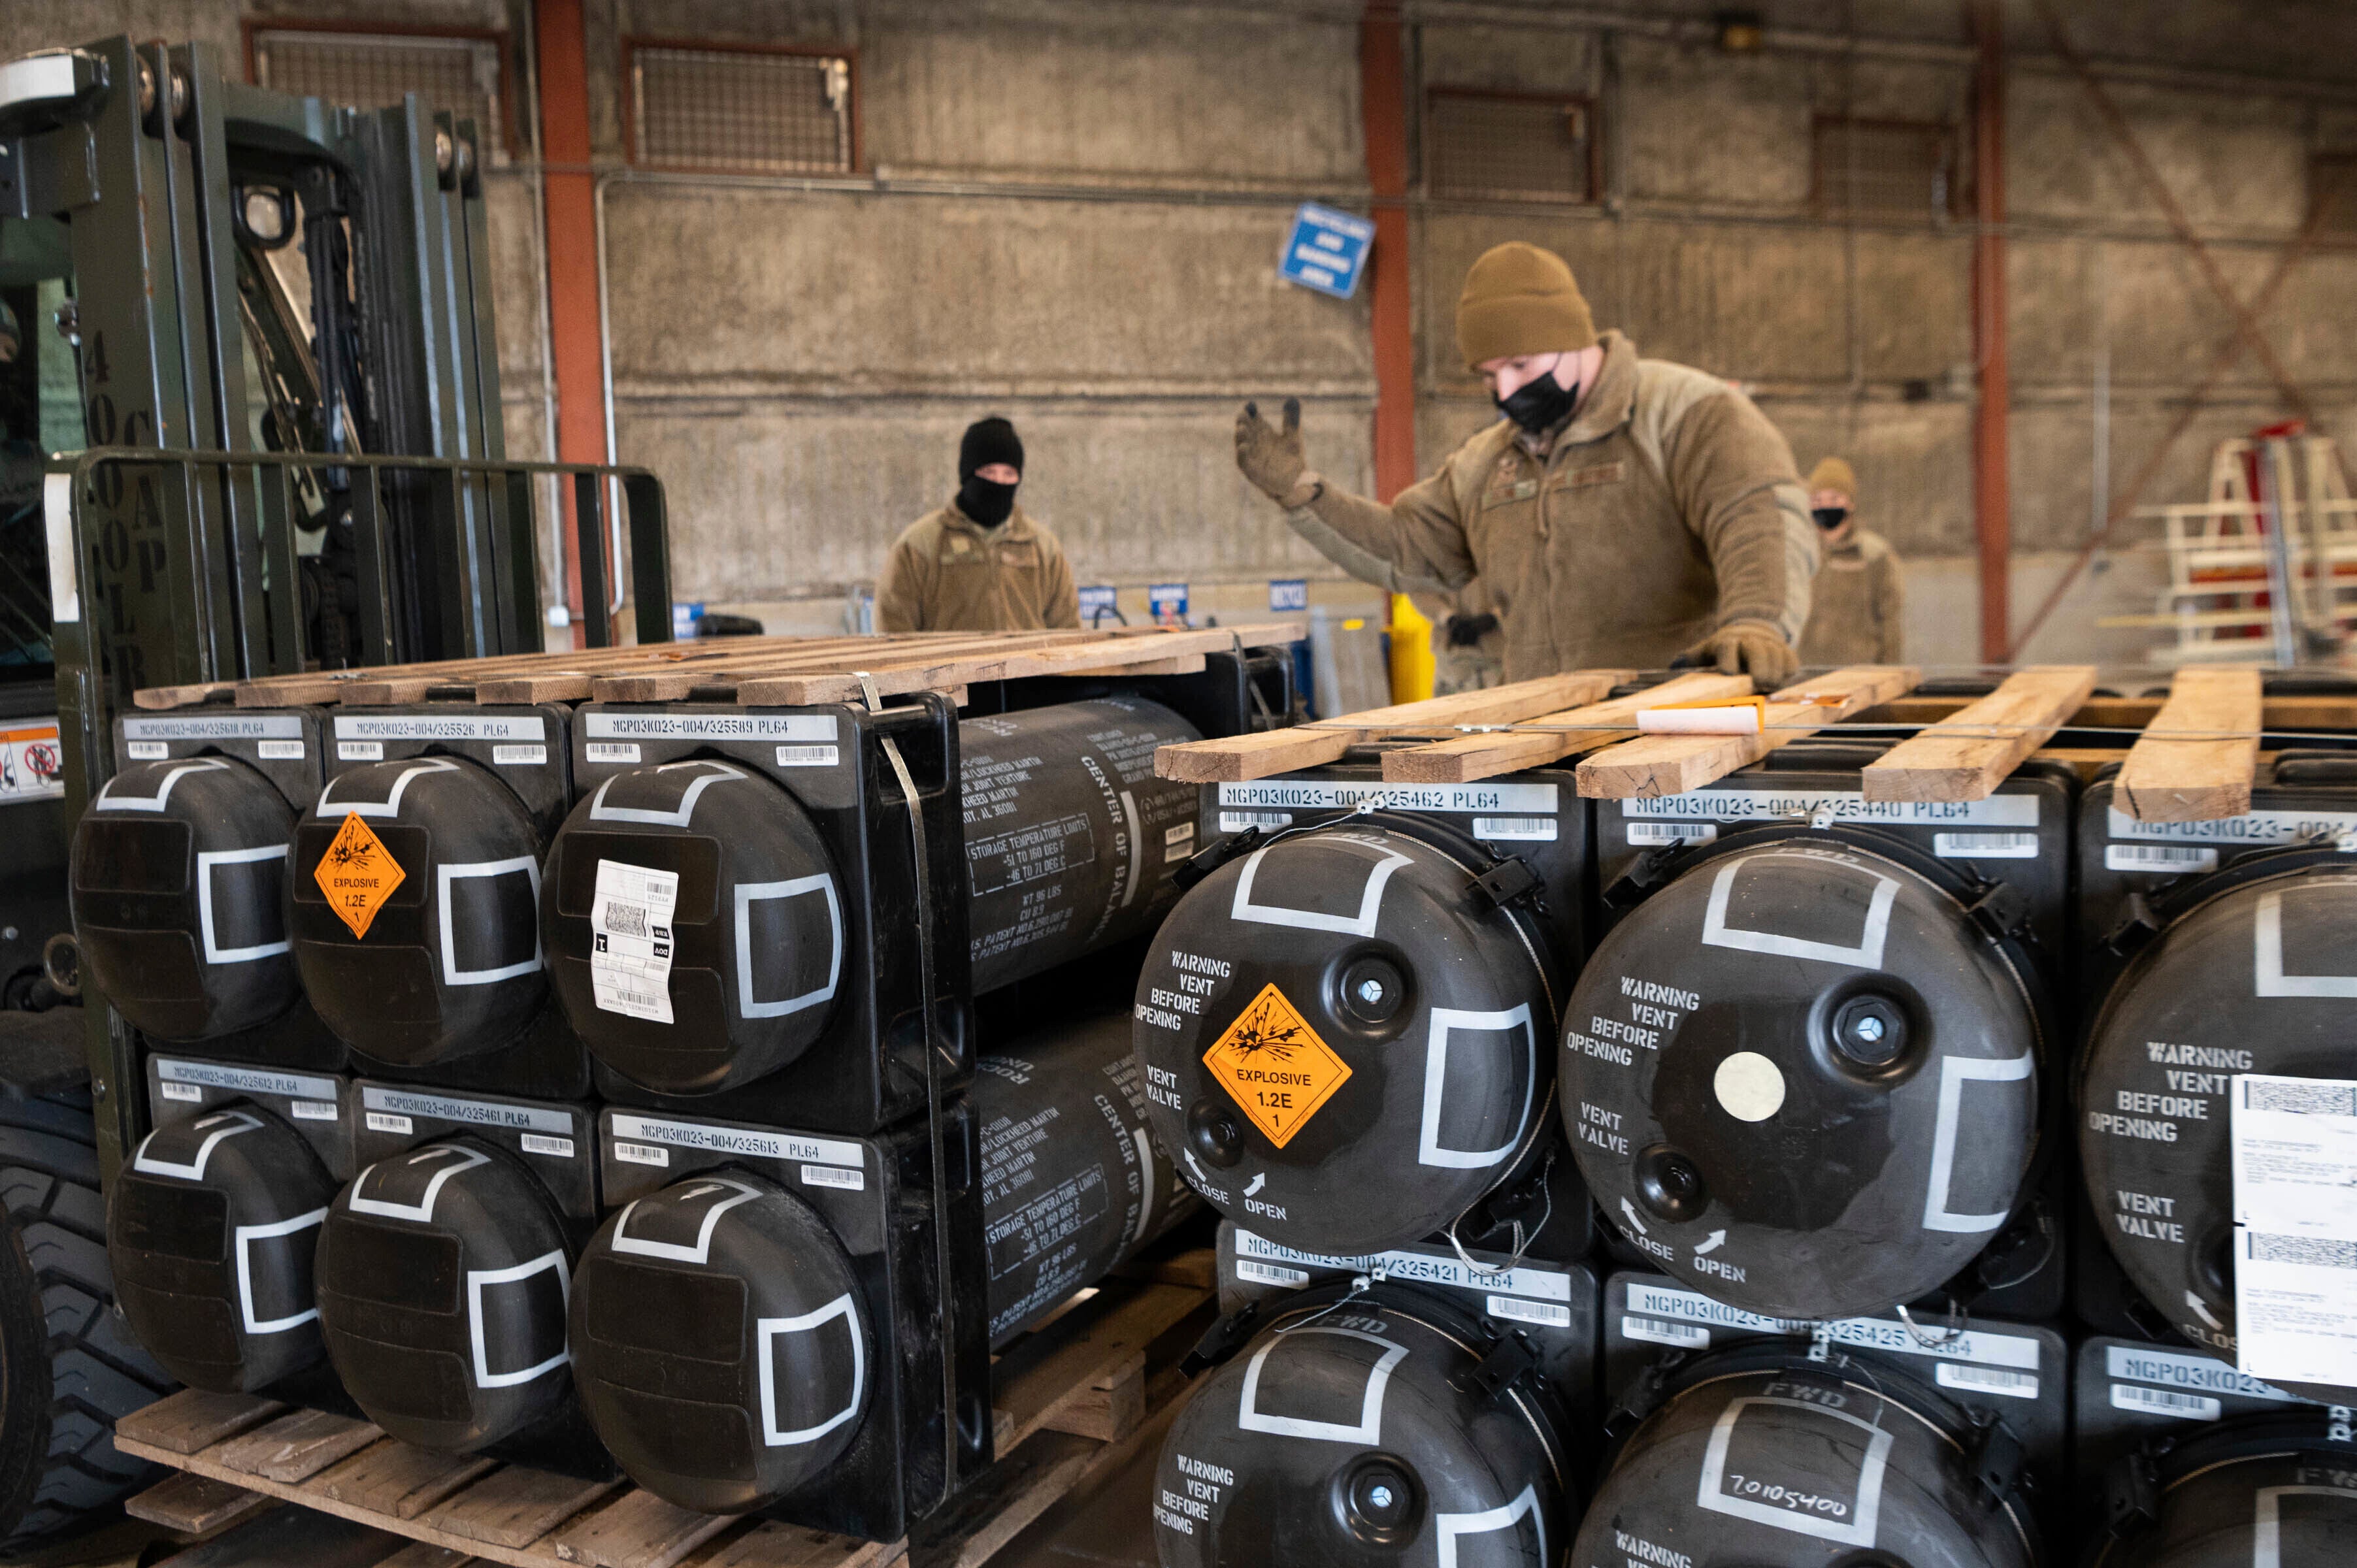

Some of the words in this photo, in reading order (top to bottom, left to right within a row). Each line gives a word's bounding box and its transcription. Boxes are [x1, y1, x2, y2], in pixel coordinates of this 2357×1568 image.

[124, 410, 166, 592] CAP
[242, 723, 265, 734] PL64
[357, 723, 475, 736] MGP03K023-004/325526
[484, 725, 508, 736] PL64
[613, 719, 753, 734] MGP03K023-004/325589
[759, 721, 788, 734] PL64
[1012, 757, 1044, 769] MARTIN
[972, 777, 995, 791] JOINT
[994, 771, 1032, 785] VENTURE
[987, 787, 1019, 802] MARTIN
[980, 808, 993, 819] AL
[1081, 756, 1123, 824] CENTER
[1115, 832, 1127, 857] OF
[1454, 792, 1500, 808] PL64
[971, 842, 1008, 860] STORAGE
[1009, 825, 1062, 849] TEMPERATURE
[1063, 819, 1087, 835] LIMITS
[1003, 855, 1015, 867] -51
[1017, 851, 1028, 864] TO
[1030, 848, 1042, 859] 160
[1044, 842, 1058, 855] DEG
[1060, 840, 1065, 851] F
[1022, 866, 1032, 877] TO
[1034, 862, 1042, 874] 71
[1044, 858, 1059, 872] DEG
[1060, 855, 1066, 866] C
[333, 878, 380, 889] EXPLOSIVE
[1047, 885, 1062, 900] LBS
[345, 894, 367, 907] 1.2E
[354, 911, 360, 923] 1
[597, 939, 605, 951] 1
[984, 926, 1015, 947] PATENT
[655, 948, 668, 956] DOV
[1172, 950, 1230, 978] WARNING
[1180, 973, 1215, 996] VENT
[1621, 976, 1700, 1011] WARNING
[1151, 987, 1200, 1014] BEFORE
[1136, 1004, 1181, 1031] OPENING
[1632, 1002, 1679, 1030] VENT
[1591, 1016, 1660, 1050] BEFORE
[1567, 1032, 1632, 1066] OPENING
[2146, 1041, 2253, 1070] WARNING
[276, 1080, 297, 1092] PL64
[1147, 1064, 1177, 1089] VENT
[1237, 1069, 1312, 1086] EXPLOSIVE
[2166, 1070, 2231, 1095] VENT
[1146, 1083, 1181, 1110] VALVE
[1257, 1091, 1293, 1109] 1.2E
[2117, 1090, 2208, 1120] BEFORE
[384, 1096, 501, 1122] MGP03K023-004/325461
[505, 1113, 530, 1126] PL64
[1029, 1107, 1061, 1128] MARTIN
[1272, 1114, 1280, 1128] 1
[1581, 1102, 1622, 1131] VENT
[1578, 1122, 1629, 1156] VALVE
[2090, 1111, 2178, 1142] OPENING
[642, 1124, 779, 1154] MGP03K023-004/325613
[789, 1144, 819, 1159] PL64
[991, 1146, 1013, 1164] JOINT
[1012, 1128, 1048, 1152] VENTURE
[1095, 1094, 1135, 1165] CENTER
[1128, 1171, 1140, 1195] OF
[1005, 1151, 1036, 1174] MARTIN
[998, 1183, 1010, 1196] AL
[1187, 1175, 1230, 1205] CLOSE
[990, 1215, 1026, 1244] STORAGE
[1026, 1183, 1078, 1220] TEMPERATURE
[1080, 1171, 1102, 1192] LIMITS
[1244, 1198, 1287, 1221] OPEN
[2117, 1190, 2175, 1218] VENT
[1021, 1229, 1032, 1241] -51
[1034, 1219, 1044, 1233] TO
[1046, 1213, 1059, 1228] 160
[1060, 1204, 1073, 1220] DEG
[1076, 1198, 1080, 1210] F
[2116, 1214, 2185, 1244] VALVE
[1039, 1233, 1049, 1247] TO
[1619, 1225, 1675, 1262] CLOSE
[1694, 1256, 1747, 1284] OPEN
[1316, 1315, 1388, 1333] FWD
[2182, 1324, 2237, 1352] CLOS
[1764, 1382, 1847, 1407] FWD
[1177, 1454, 1234, 1486] WARNING
[1187, 1478, 1220, 1503] VENT
[1162, 1489, 1209, 1521] BEFORE
[1615, 1529, 1692, 1568] WARNING
